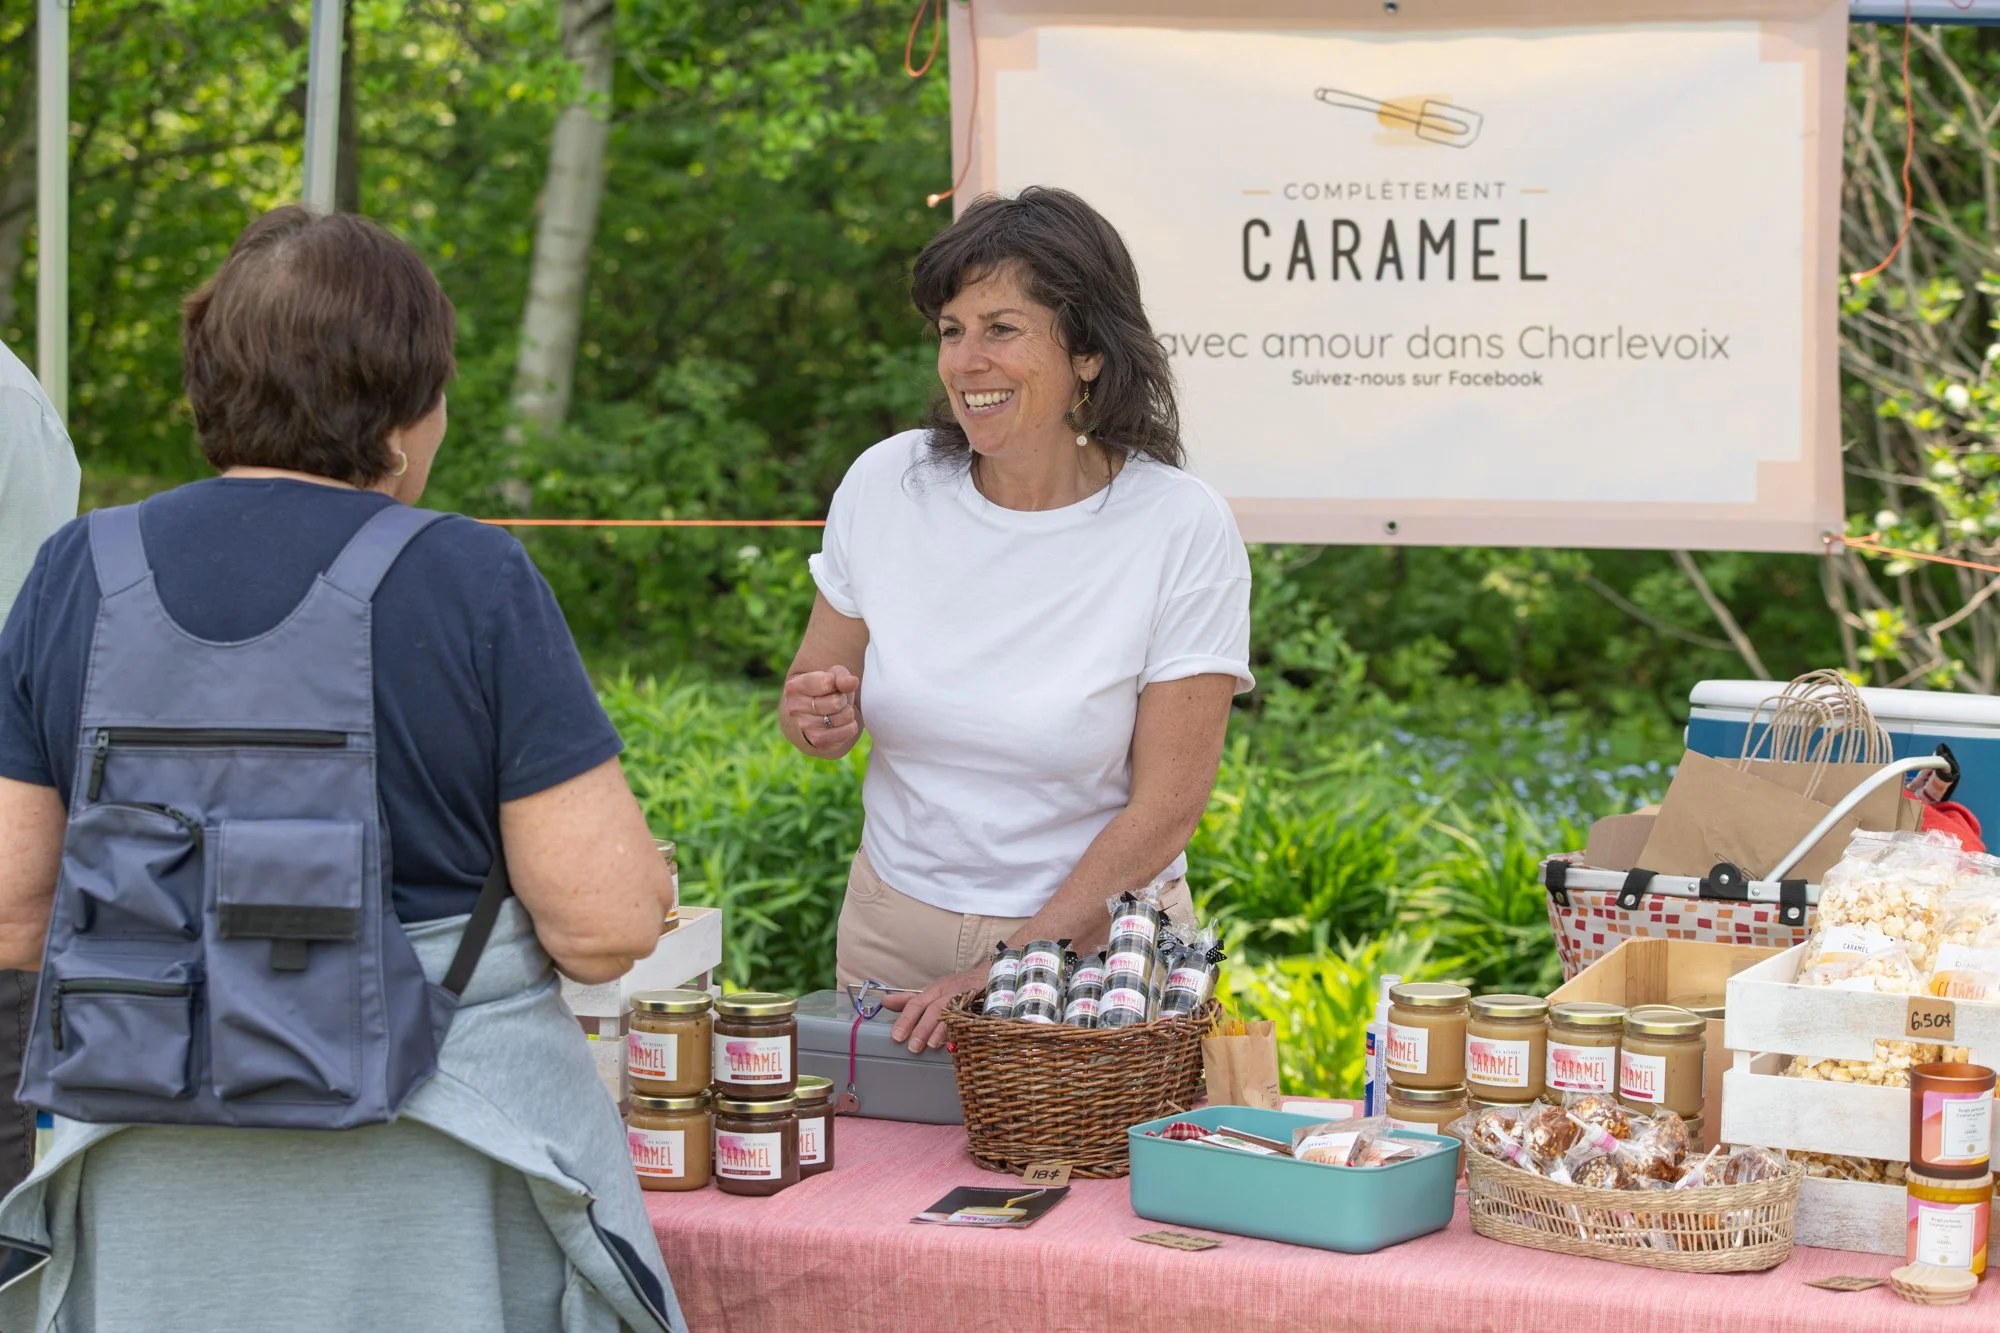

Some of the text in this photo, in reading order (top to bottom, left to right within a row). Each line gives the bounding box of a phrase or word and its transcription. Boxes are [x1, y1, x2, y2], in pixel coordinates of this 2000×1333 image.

[1284, 179, 1507, 201] COMPLÈTEMENT
[1242, 218, 1548, 281] CARAMEL
[1158, 325, 1730, 361] avec amour dans Charlevoix
[1291, 369, 1543, 387] Suivez-nous sur Facebook
[1843, 943, 1869, 954] CARAMEL
[730, 1051, 782, 1073] CARAMEL
[1471, 1052, 1520, 1077] CARAMEL
[1555, 1059, 1607, 1082] CARAMEL
[720, 1146, 772, 1168] CARAMEL
[1031, 1169, 1061, 1181] 18$
